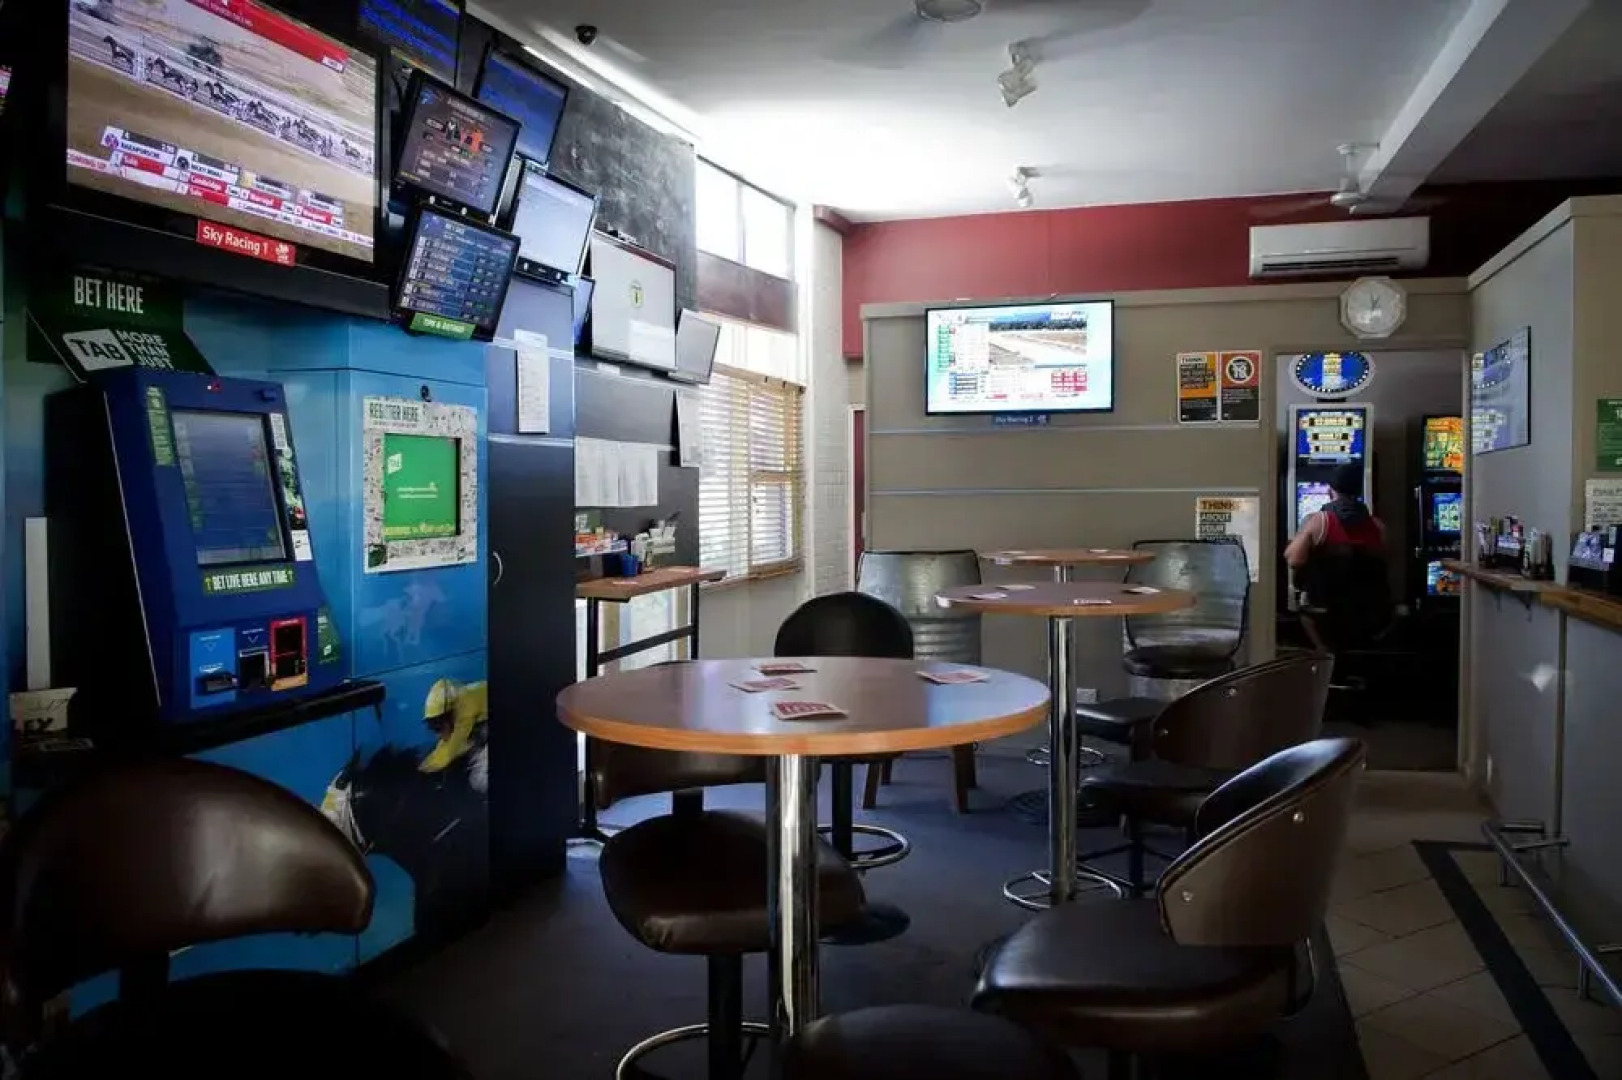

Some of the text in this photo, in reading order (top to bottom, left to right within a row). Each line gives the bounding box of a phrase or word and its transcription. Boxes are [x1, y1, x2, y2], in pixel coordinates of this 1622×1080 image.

[203, 226, 268, 256] Sky Racing 1
[74, 275, 144, 314] BET HERE
[116, 329, 163, 344] MORE
[69, 338, 126, 361] TAB
[1201, 513, 1230, 521] ABOUT
[212, 575, 226, 590] BET
[241, 572, 258, 587] HERE
